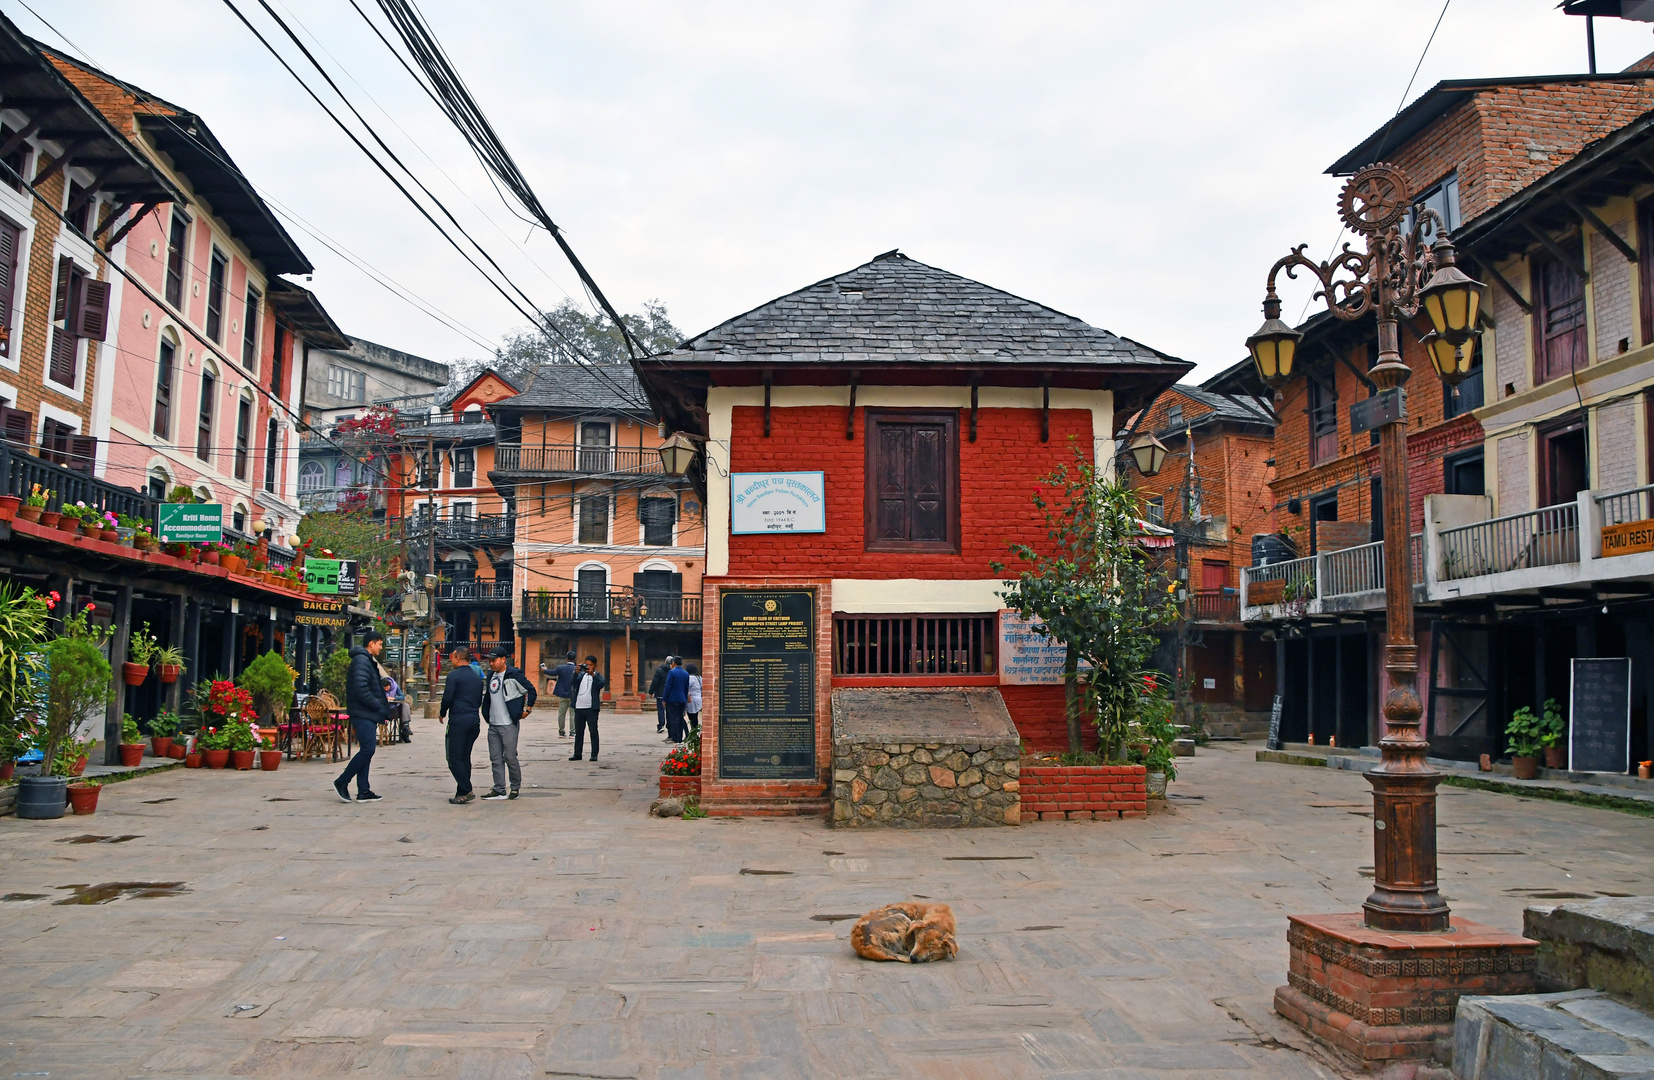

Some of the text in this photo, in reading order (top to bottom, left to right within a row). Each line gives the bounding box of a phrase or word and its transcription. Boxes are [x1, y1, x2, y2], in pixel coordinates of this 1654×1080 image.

[1347, 201, 1405, 229] INTERNATIONAL
[736, 493, 746, 504] श्री
[1604, 533, 1627, 549] TAMU
[303, 601, 343, 611] BAKERY
[295, 615, 346, 627] RESTAURANT
